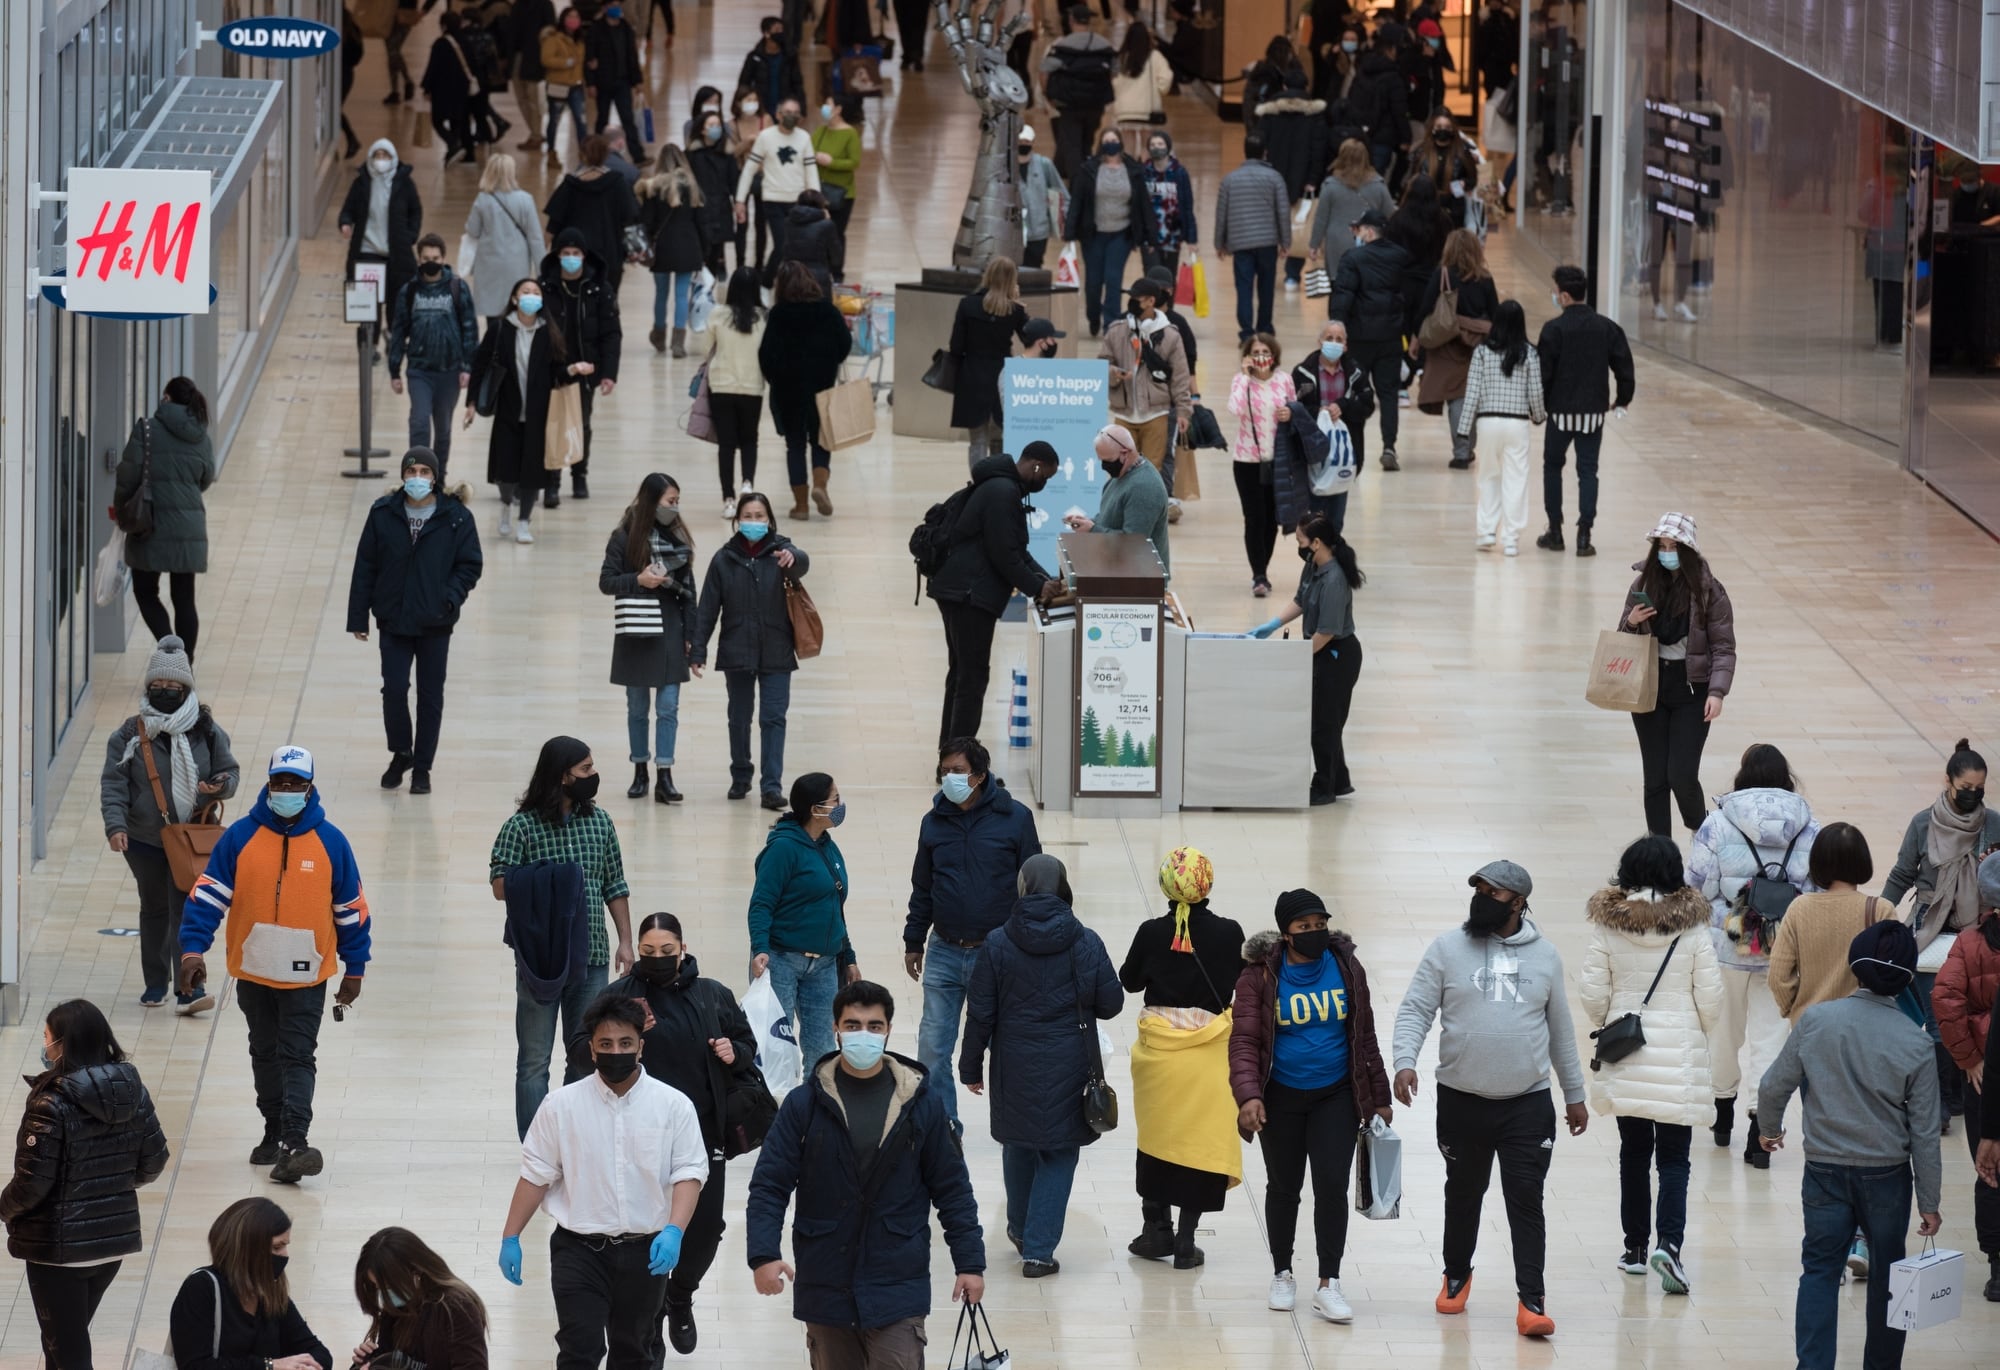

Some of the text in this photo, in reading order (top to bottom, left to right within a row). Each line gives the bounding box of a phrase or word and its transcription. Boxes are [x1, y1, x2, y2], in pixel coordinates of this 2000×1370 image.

[229, 28, 327, 48] OLD NAVY
[76, 200, 201, 284] H&M
[1012, 374, 1102, 392] We're happy
[1011, 391, 1094, 407] you're here
[1093, 673, 1112, 682] 706
[1119, 705, 1149, 714] 12,714
[1274, 989, 1347, 1026] LOVE
[1930, 1287, 1952, 1301] ALDO
